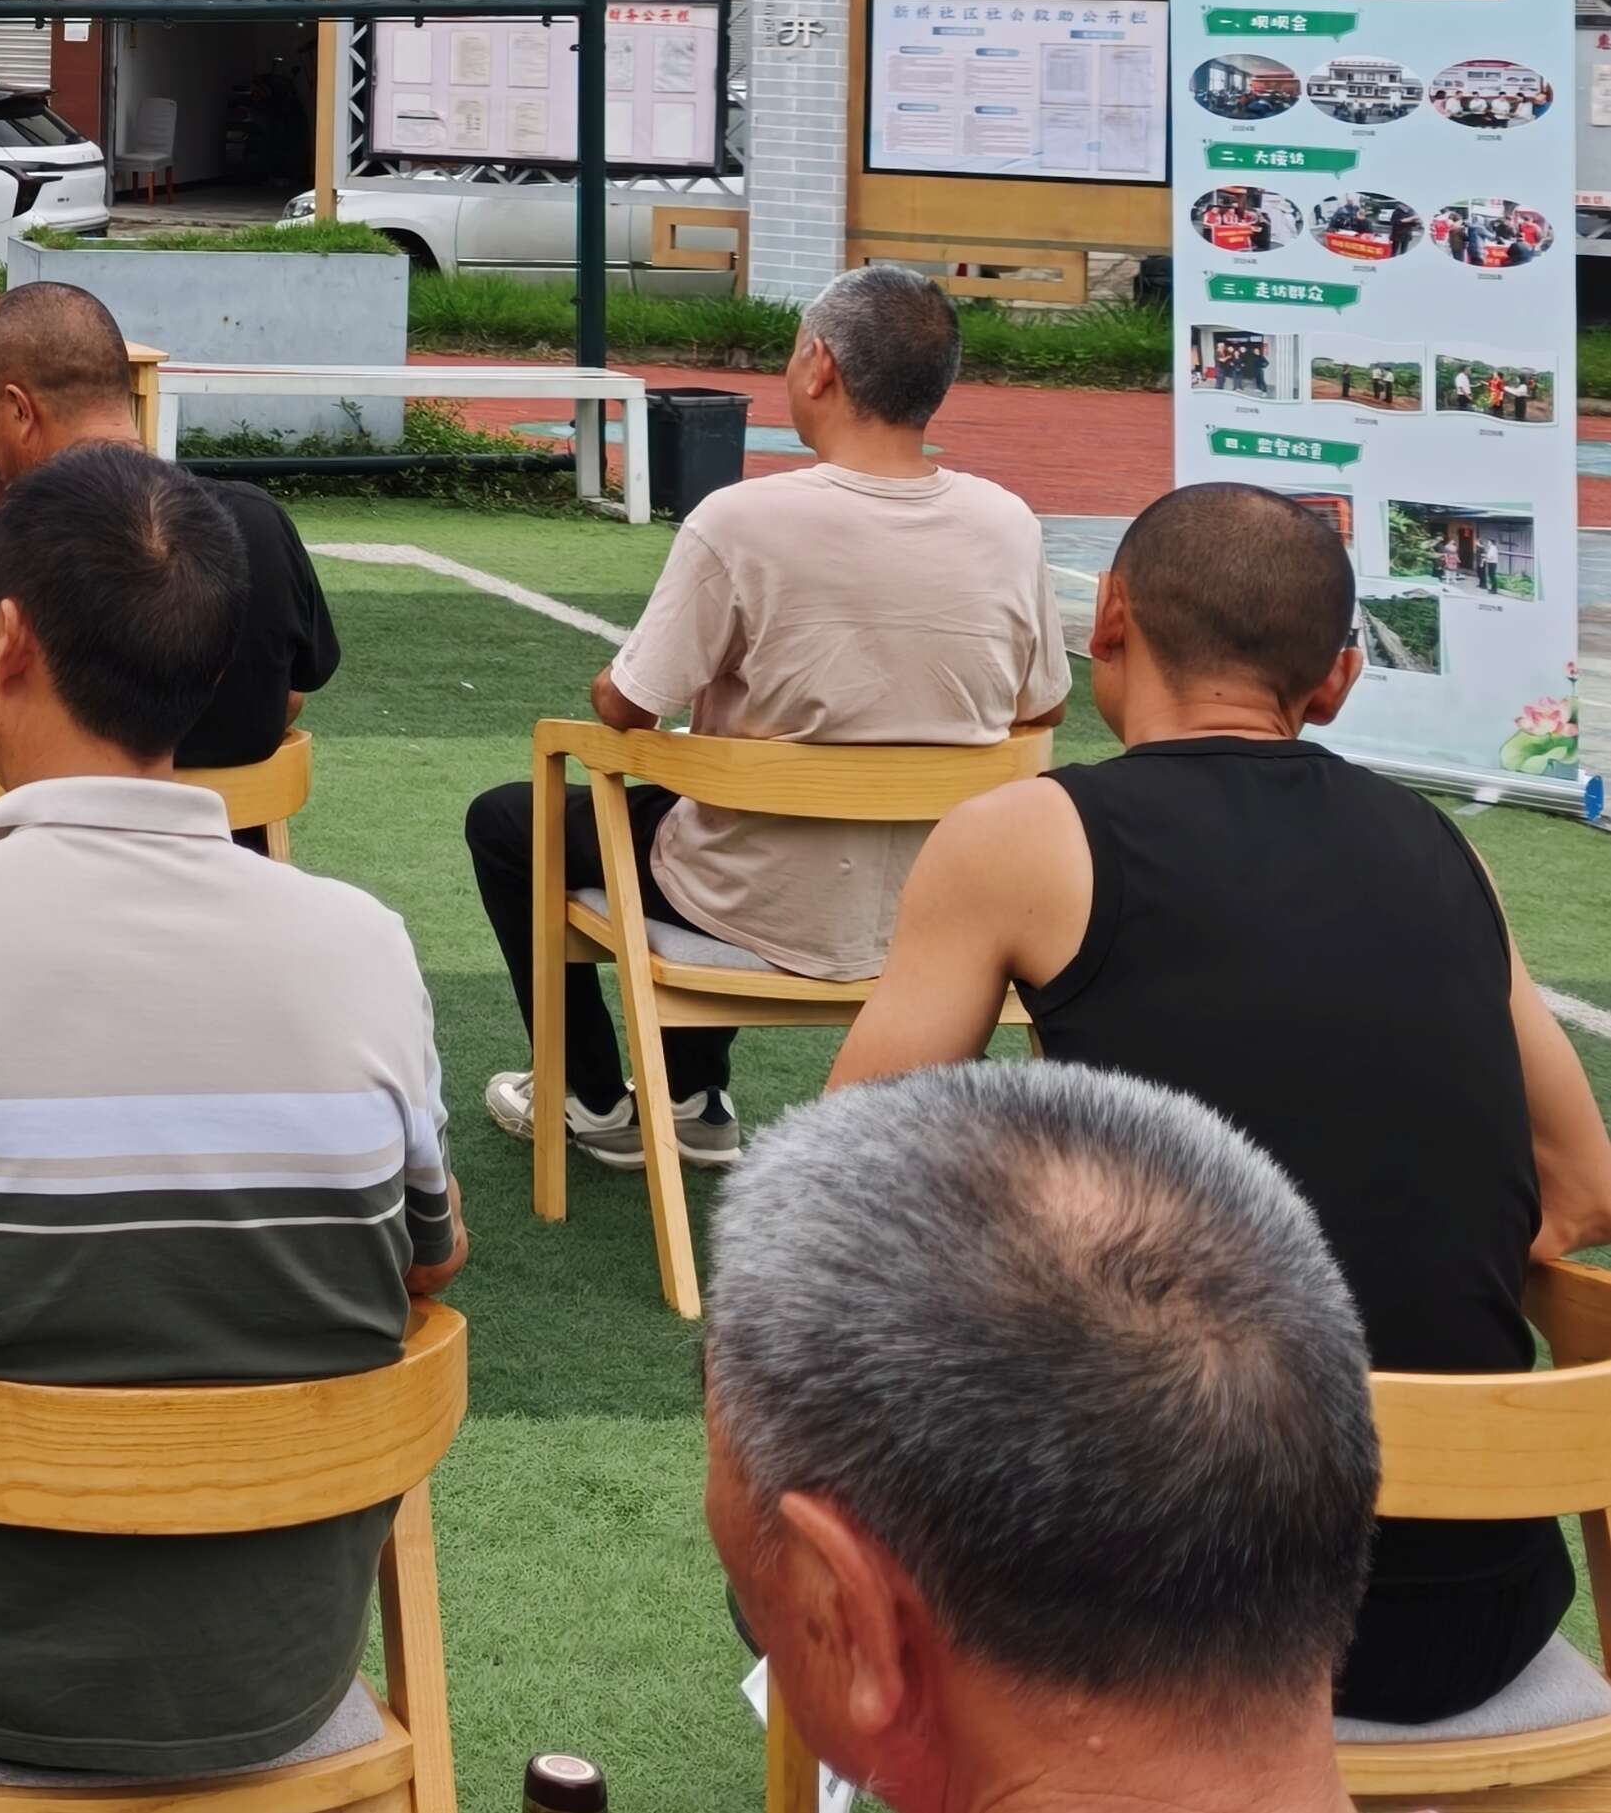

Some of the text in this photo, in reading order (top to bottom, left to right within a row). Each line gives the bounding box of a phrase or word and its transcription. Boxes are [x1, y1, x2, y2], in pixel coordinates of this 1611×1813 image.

[1222, 282, 1325, 302] 三、走访群众
